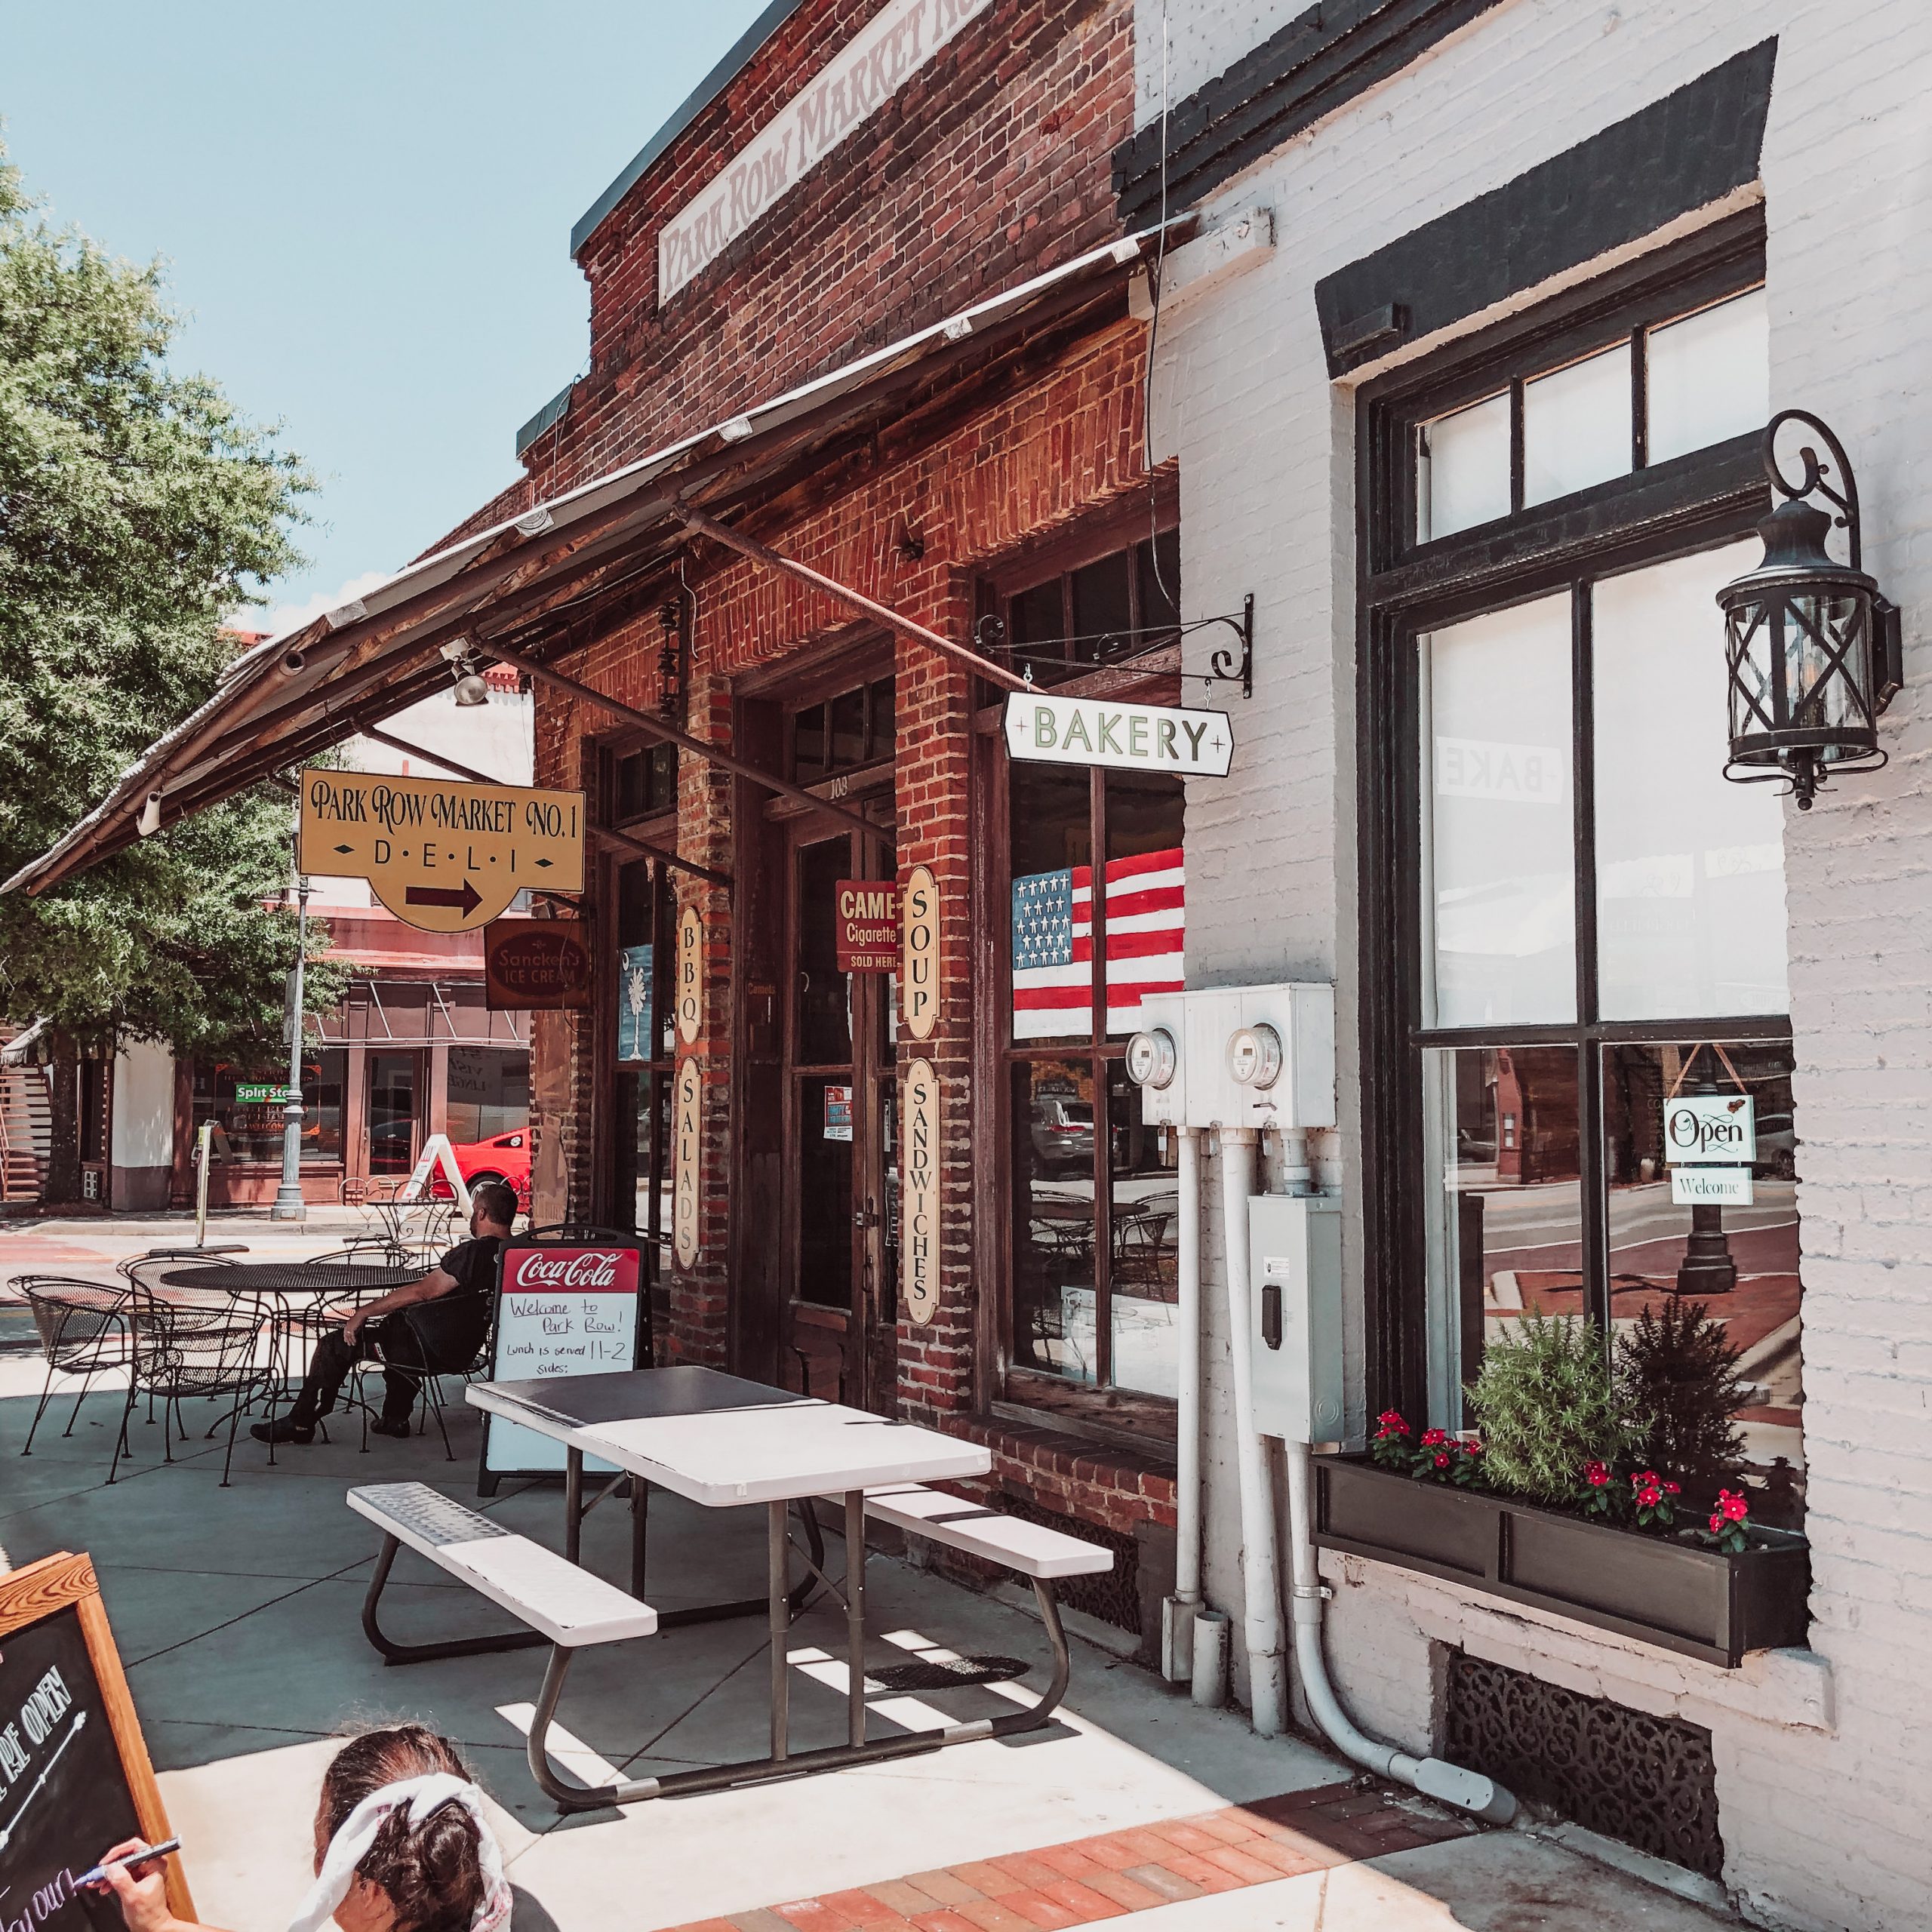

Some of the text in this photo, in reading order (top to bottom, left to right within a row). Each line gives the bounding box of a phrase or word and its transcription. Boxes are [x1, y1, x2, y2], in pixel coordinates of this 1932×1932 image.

[663, 193, 729, 295] PARK
[728, 127, 793, 235] ROW
[796, 0, 927, 172] MARKET
[1034, 706, 1208, 761] BAKERY
[830, 776, 848, 799] 108
[311, 780, 368, 822] PARK
[372, 786, 427, 835] ROW
[431, 793, 516, 833] MARKET
[840, 891, 896, 919] CAME
[847, 923, 897, 947] Cigarette
[851, 955, 897, 968] SOLD HERE
[910, 890, 931, 1017] SOUP
[506, 970, 575, 983] ICE CREAM
[238, 1088, 266, 1099] Split
[1669, 1109, 1743, 1153] Open
[680, 1078, 694, 1250] SALADS
[909, 1083, 932, 1300] SANDWICHES
[1679, 1178, 1739, 1195] Welcome
[511, 1297, 598, 1316] Welcome to
[543, 1311, 622, 1334] Park Row!
[507, 1342, 534, 1355] Lunch
[540, 1346, 549, 1355] is
[555, 1345, 586, 1355] served
[21, 1665, 72, 1745] OPEN
